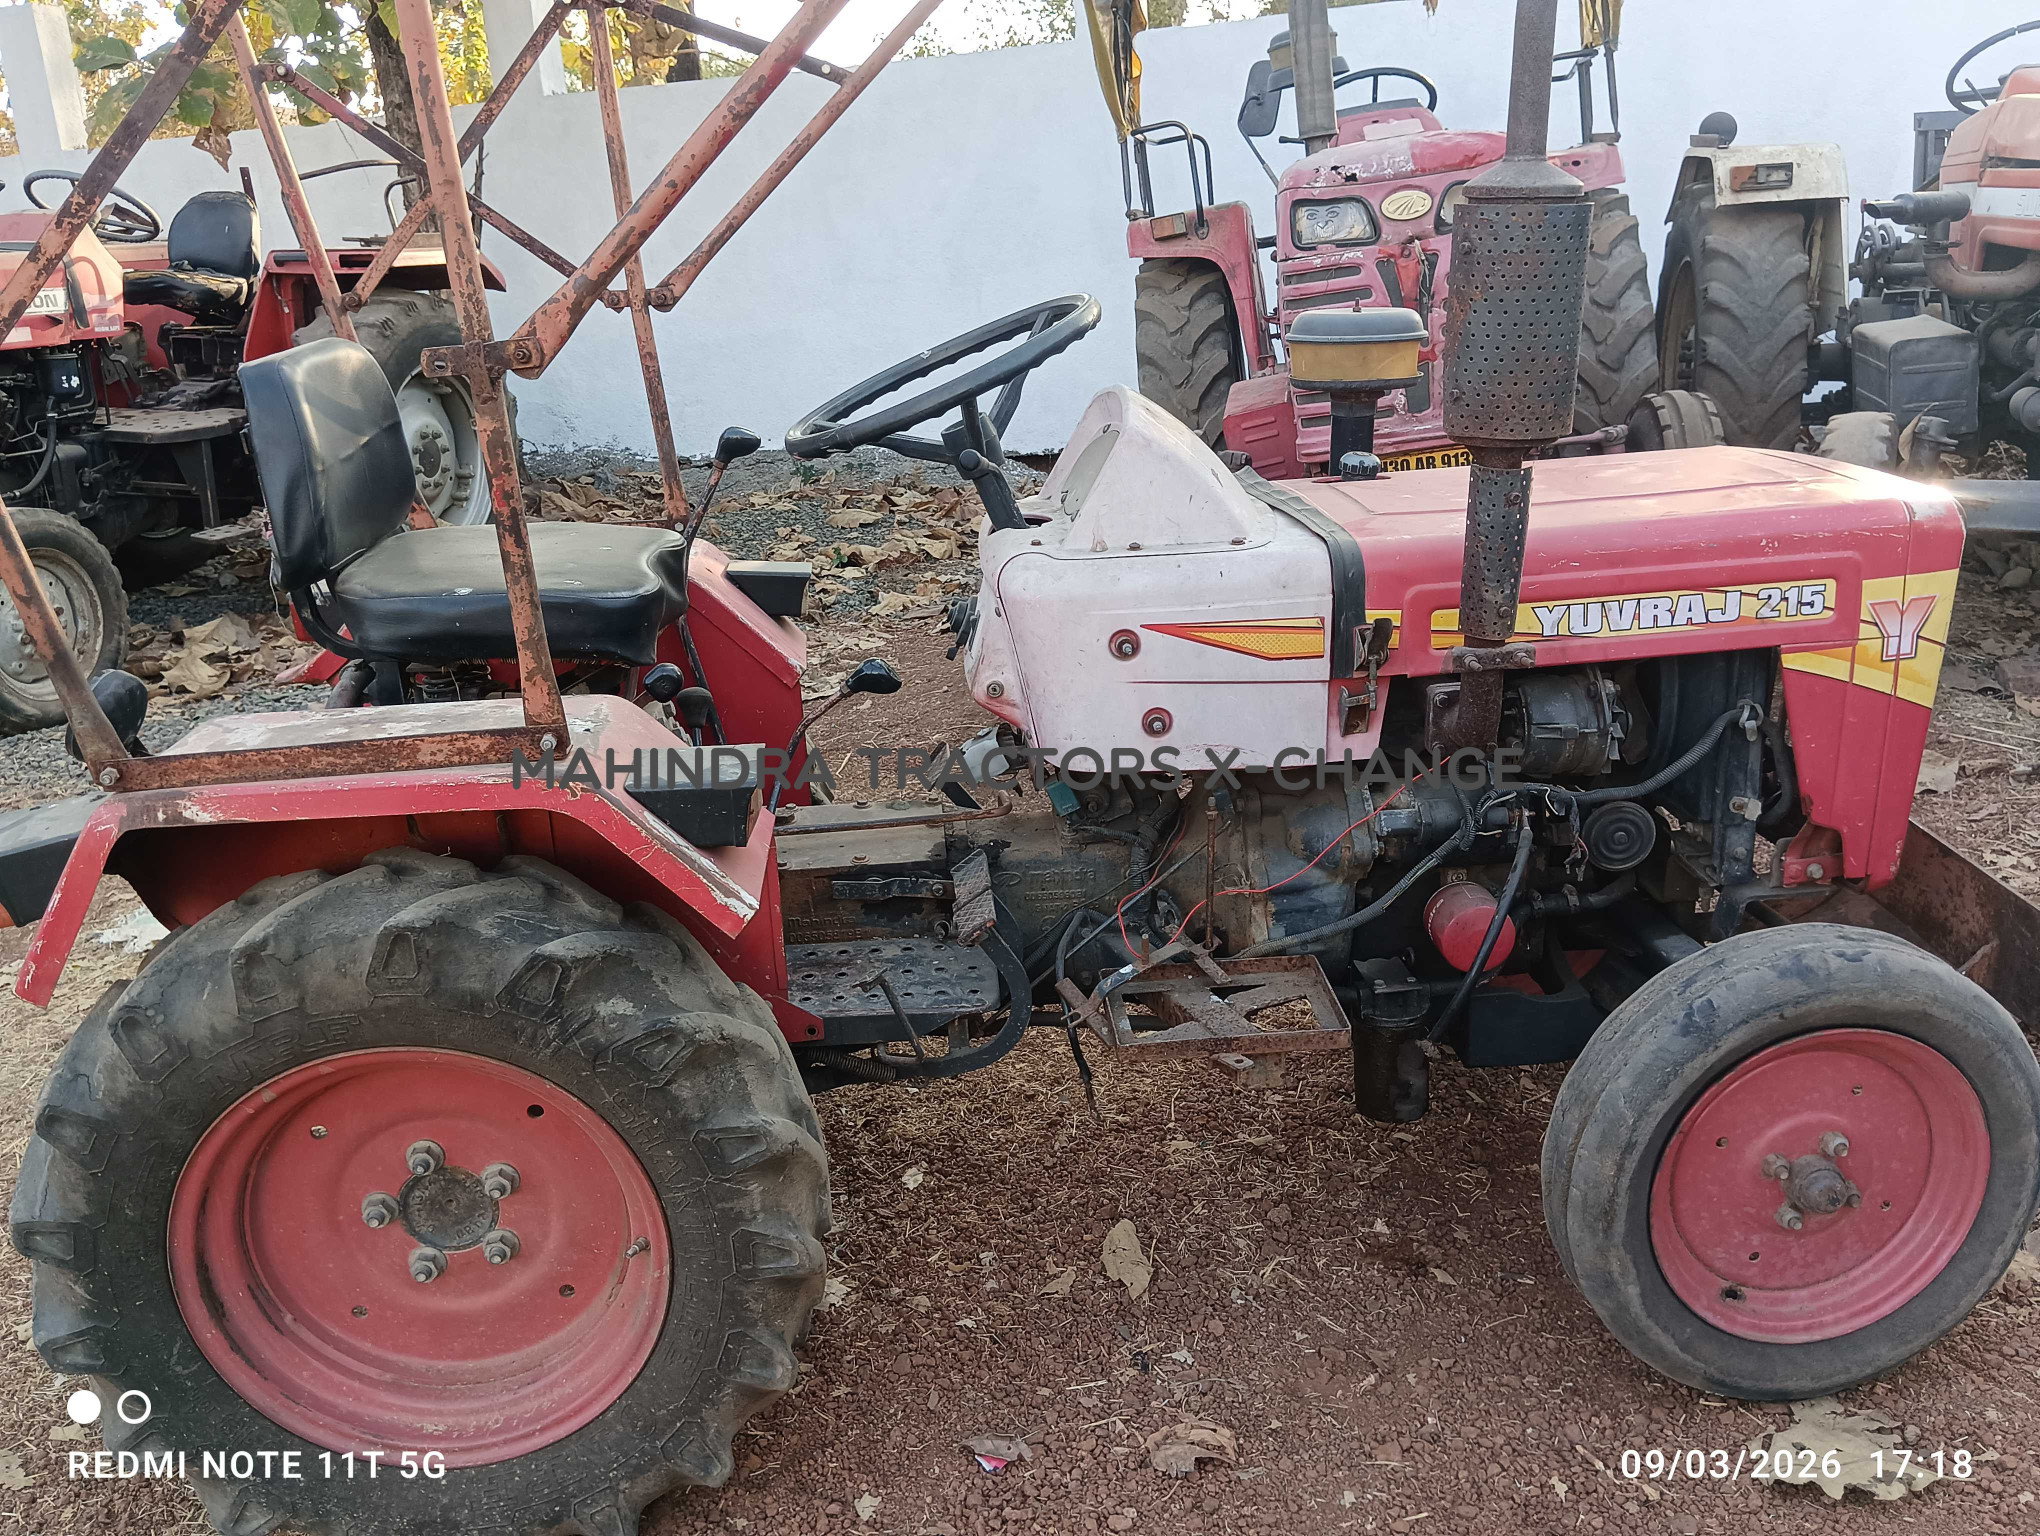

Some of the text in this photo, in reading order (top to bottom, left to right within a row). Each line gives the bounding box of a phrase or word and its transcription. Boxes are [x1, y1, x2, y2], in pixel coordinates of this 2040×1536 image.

[29, 293, 60, 309] ON
[1531, 584, 1827, 637] YUVRAJ 215
[1867, 593, 1940, 662] Y
[194, 1013, 361, 1101] MRF
